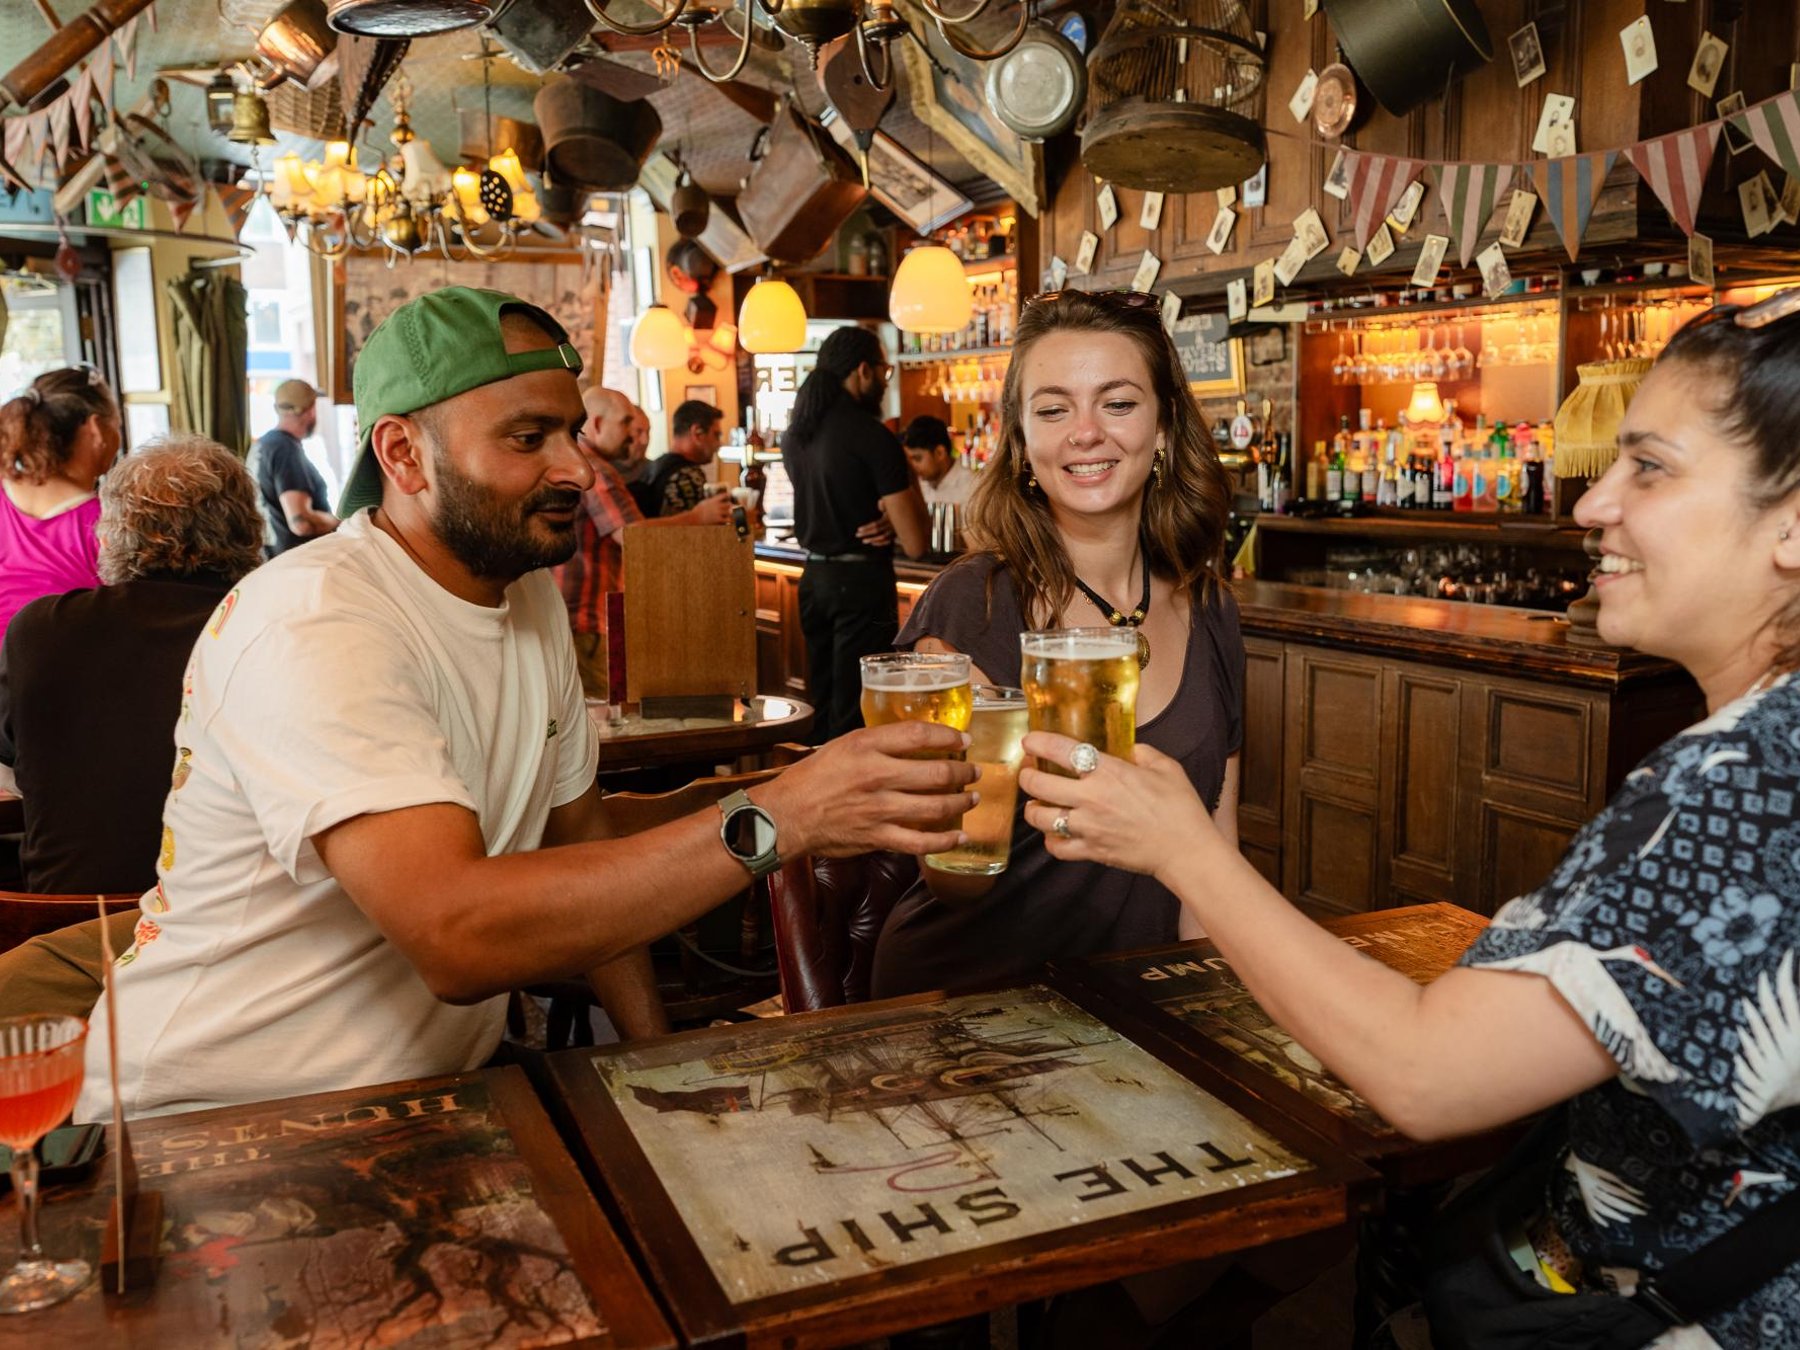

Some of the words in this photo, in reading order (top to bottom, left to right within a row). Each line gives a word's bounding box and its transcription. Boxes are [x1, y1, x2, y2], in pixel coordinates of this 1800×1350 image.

[1140, 957, 1230, 982] UMP
[1054, 1141, 1254, 1203] THE
[771, 1187, 1022, 1268] SHIP
